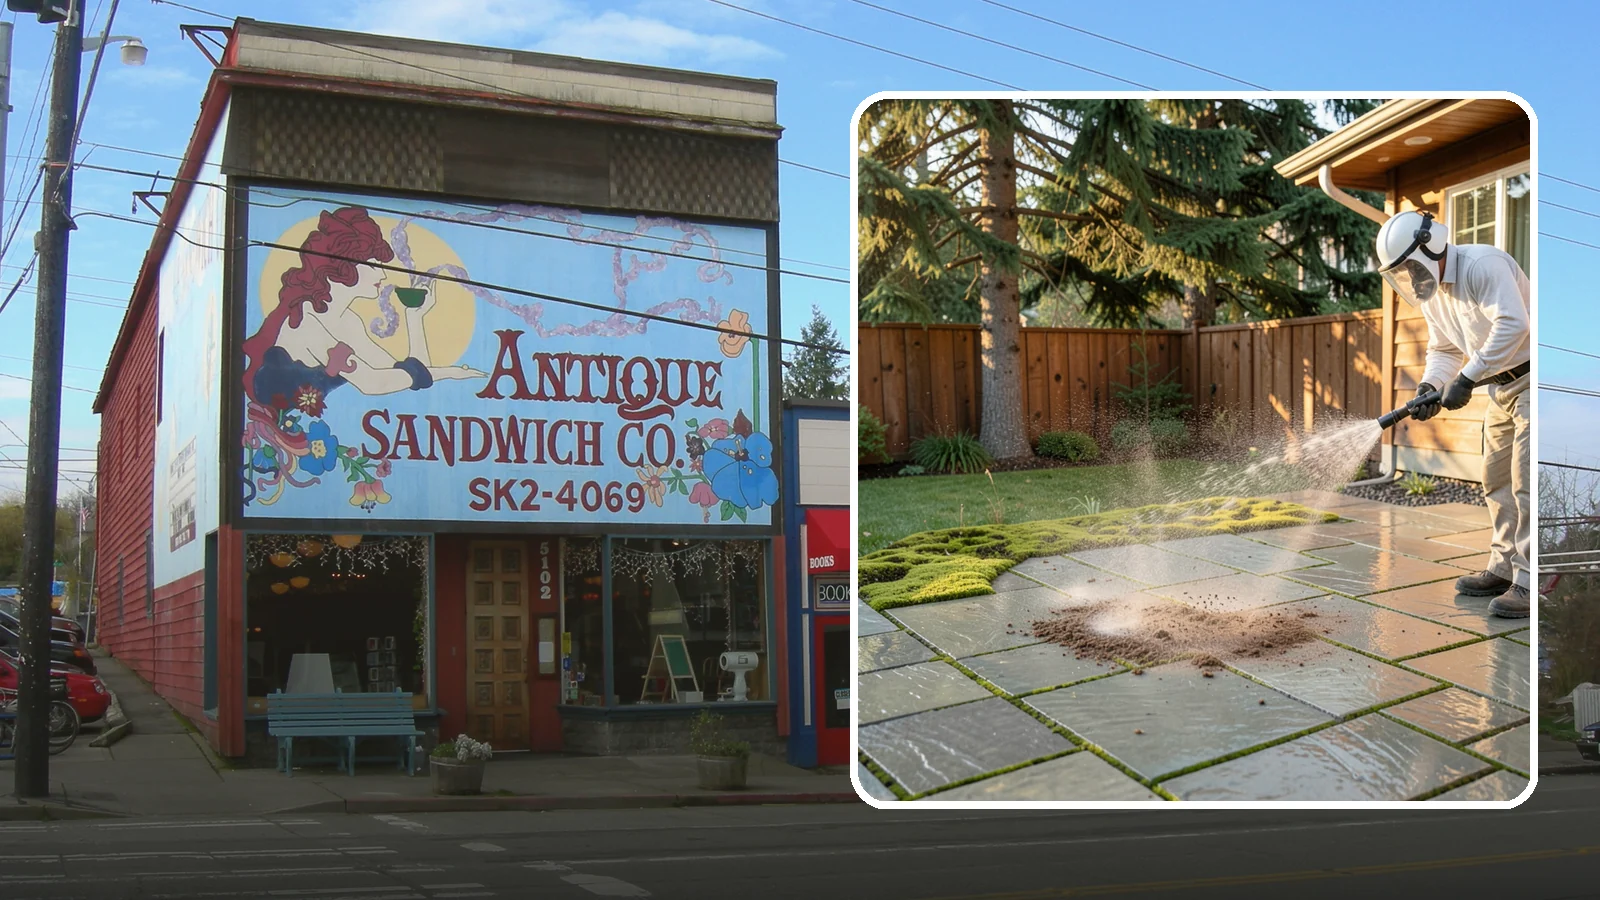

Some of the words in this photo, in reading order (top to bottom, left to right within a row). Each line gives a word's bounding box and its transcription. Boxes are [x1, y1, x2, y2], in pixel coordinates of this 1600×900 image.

[476, 329, 724, 421] ANTIQUE
[361, 408, 604, 466] SANDWICH
[617, 422, 684, 469] CO.
[468, 477, 645, 513] SK2-4069
[540, 541, 551, 600] 5102
[809, 555, 835, 569] BOOKS
